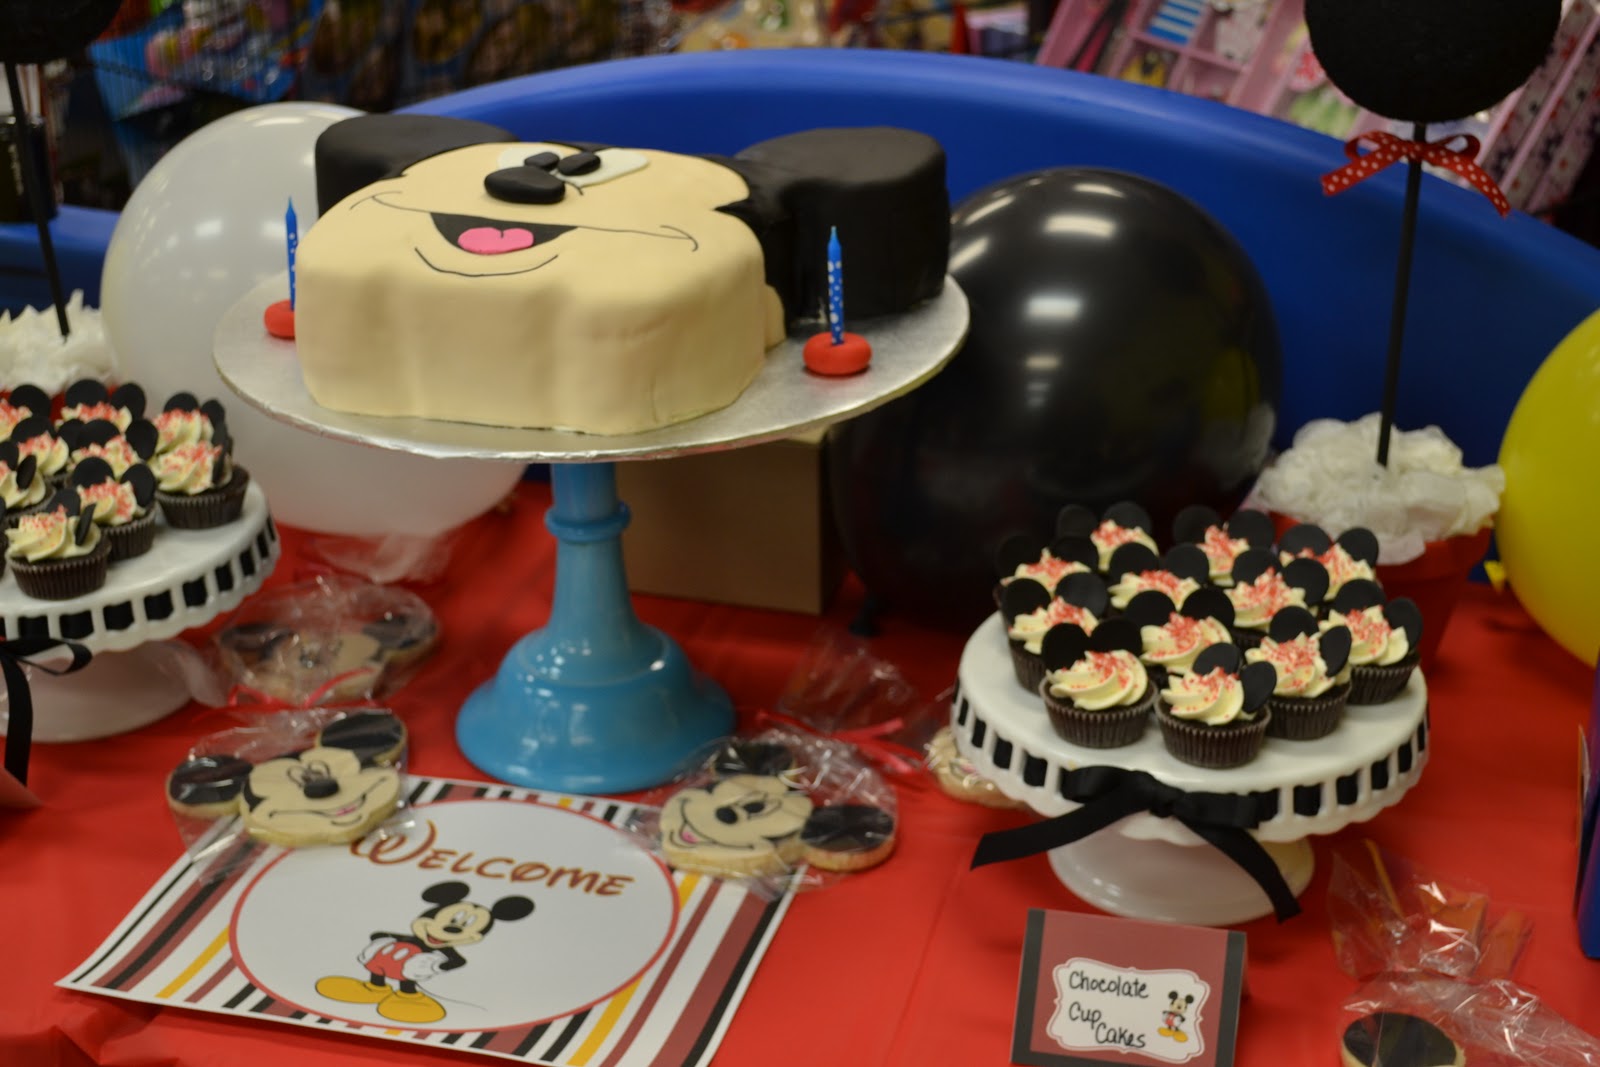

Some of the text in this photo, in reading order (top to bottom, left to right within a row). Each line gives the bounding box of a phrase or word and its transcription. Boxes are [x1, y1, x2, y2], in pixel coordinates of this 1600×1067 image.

[1069, 970, 1149, 999] Chocolate
[1069, 1002, 1102, 1030] Cup
[1095, 1022, 1146, 1048] Cakes
